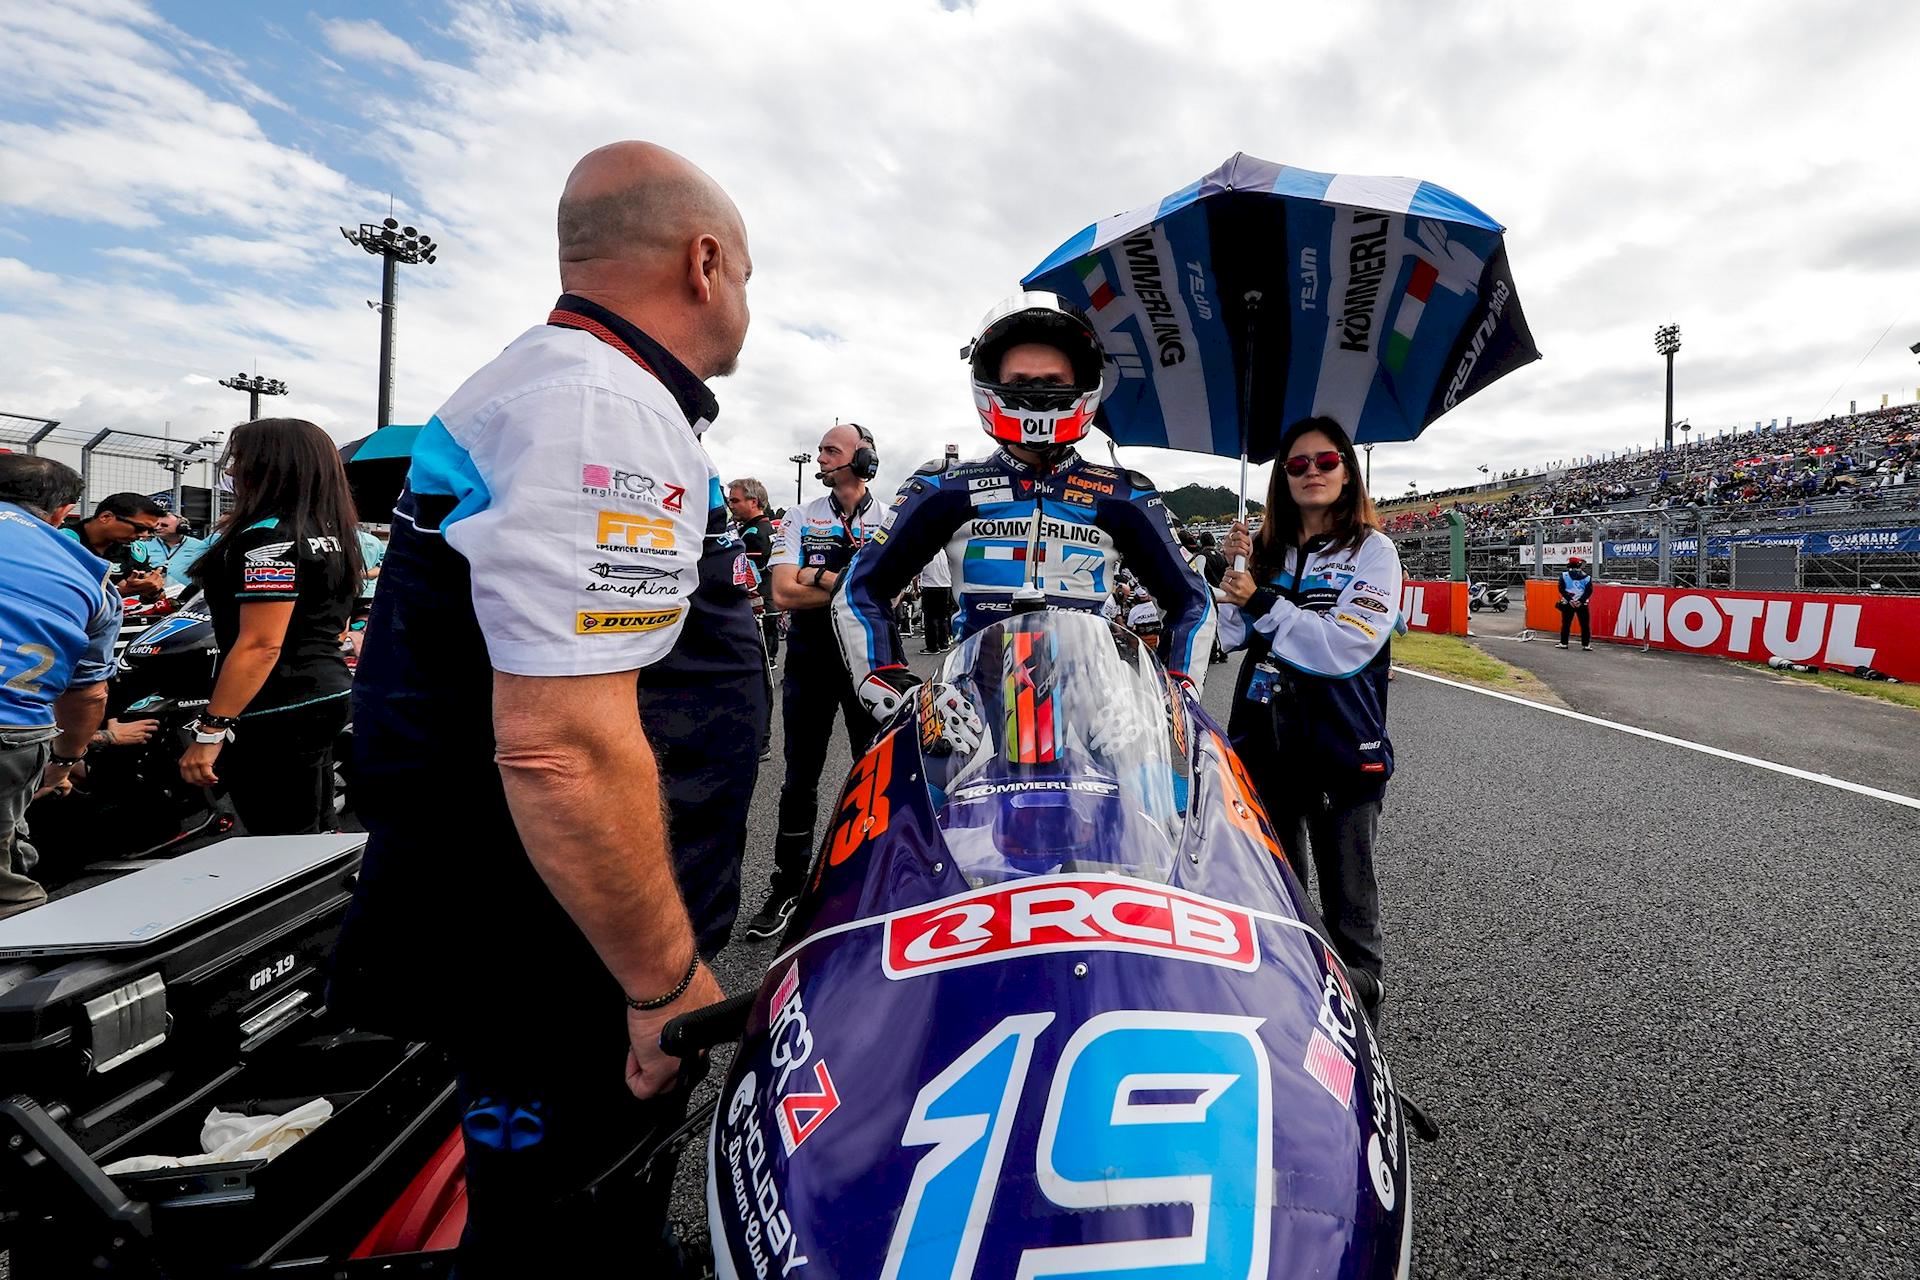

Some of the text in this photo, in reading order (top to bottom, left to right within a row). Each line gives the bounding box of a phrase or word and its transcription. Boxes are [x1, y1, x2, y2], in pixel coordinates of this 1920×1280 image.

[1301, 246, 1317, 311] TEAM
[1443, 314, 1497, 412] GRESINI
[1023, 418, 1054, 436] OLI
[977, 478, 1002, 488] OLI
[1062, 488, 1095, 505] FPS
[1067, 474, 1115, 495] Kapriol
[597, 511, 675, 548] FPS
[639, 547, 678, 557] AUTOMATION
[1622, 543, 1653, 553] YAMAHA
[244, 568, 296, 582] HRC
[245, 560, 296, 568] HONDA
[601, 613, 678, 627] DUNLOP
[1614, 592, 1877, 668] MOTUL
[1010, 887, 1241, 956] RCB
[249, 953, 295, 991] GR-19
[879, 1010, 1274, 1280] 19
[743, 1104, 809, 1278] HOLIDAY
[728, 1134, 769, 1280] Dream Club
